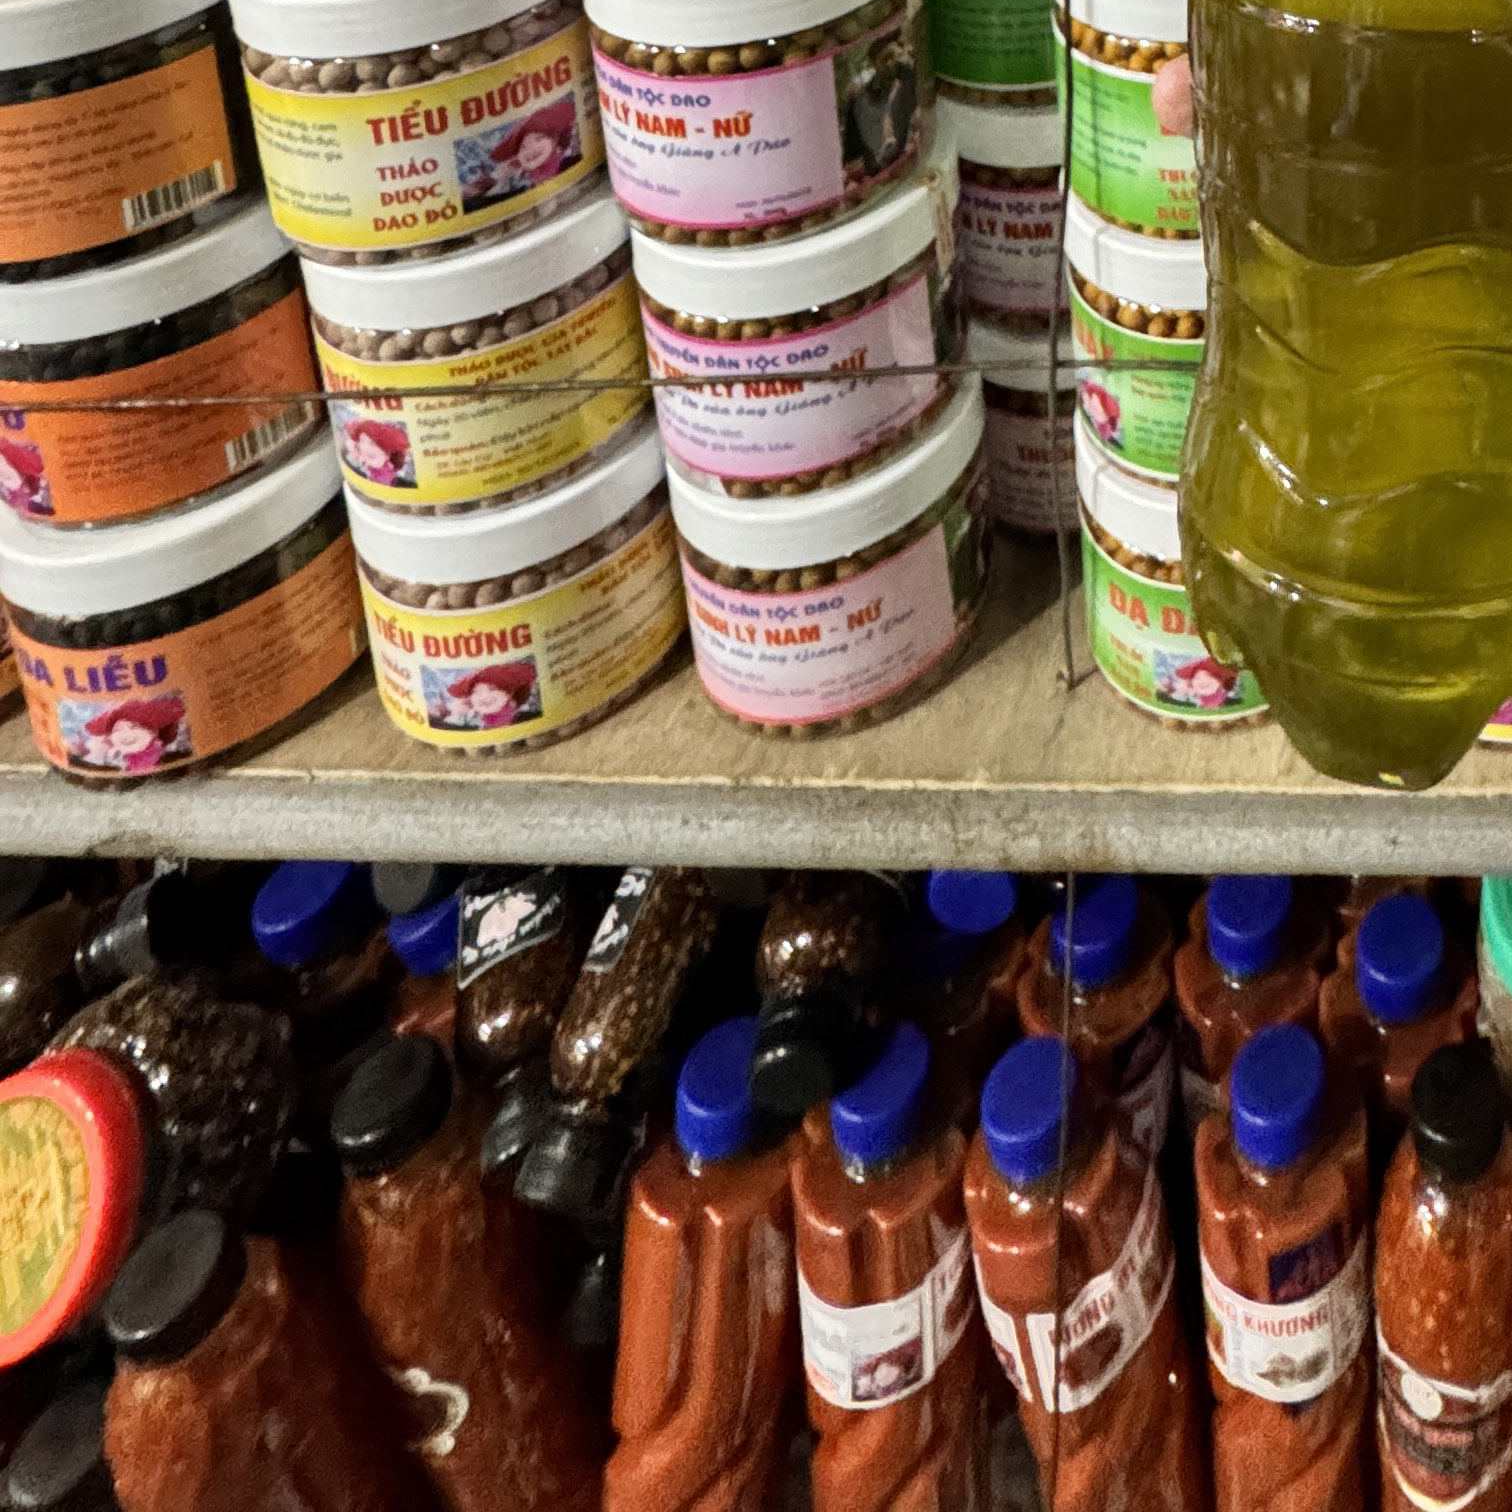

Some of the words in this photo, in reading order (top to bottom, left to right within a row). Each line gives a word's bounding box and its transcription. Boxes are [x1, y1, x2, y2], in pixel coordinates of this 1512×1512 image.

[367, 99, 449, 147] TIỂU
[461, 54, 574, 129] ĐƯỜNG
[671, 94, 711, 108] DAO
[636, 110, 688, 139] NAM
[712, 109, 754, 139] NỮ
[377, 156, 439, 183] THẢO
[373, 211, 418, 233] DAO
[425, 201, 459, 228] ĐỎ
[1109, 582, 1150, 631] DẠ
[373, 607, 415, 653] TIỂU
[423, 621, 533, 659] ĐƯỜNG
[764, 624, 821, 646] NAM
